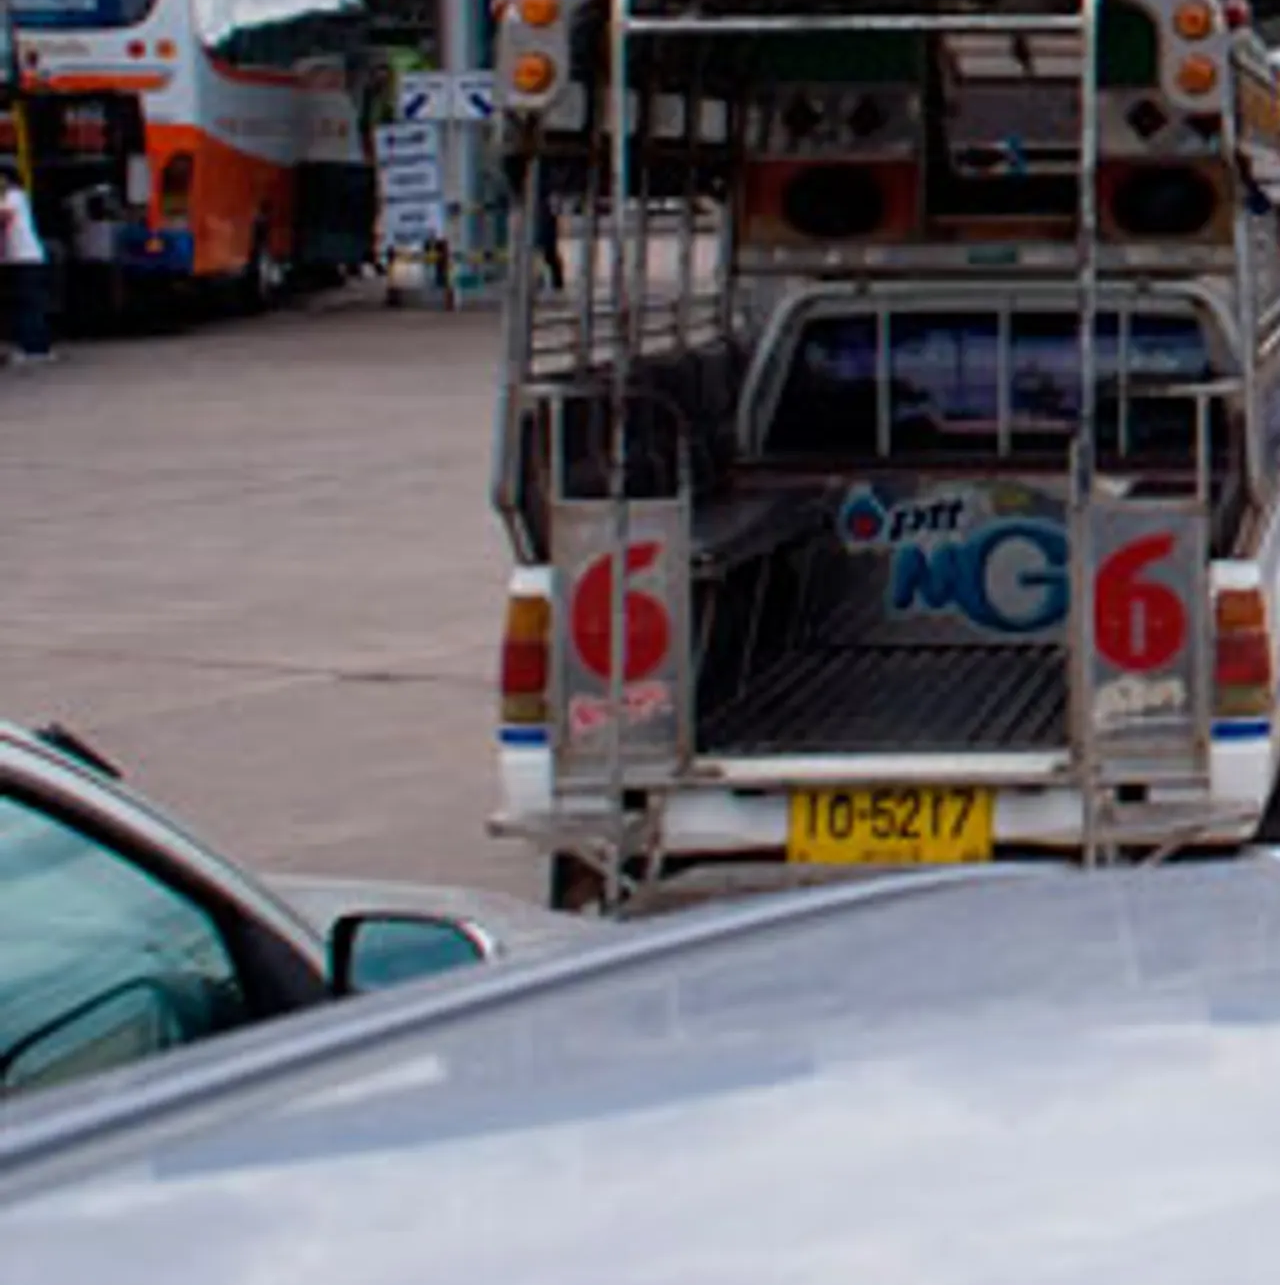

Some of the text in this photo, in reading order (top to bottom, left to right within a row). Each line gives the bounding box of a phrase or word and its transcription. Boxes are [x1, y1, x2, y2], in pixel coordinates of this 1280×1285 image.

[570, 539, 674, 684] 6
[1093, 528, 1189, 673] 6
[808, 785, 977, 840] 10-5217
